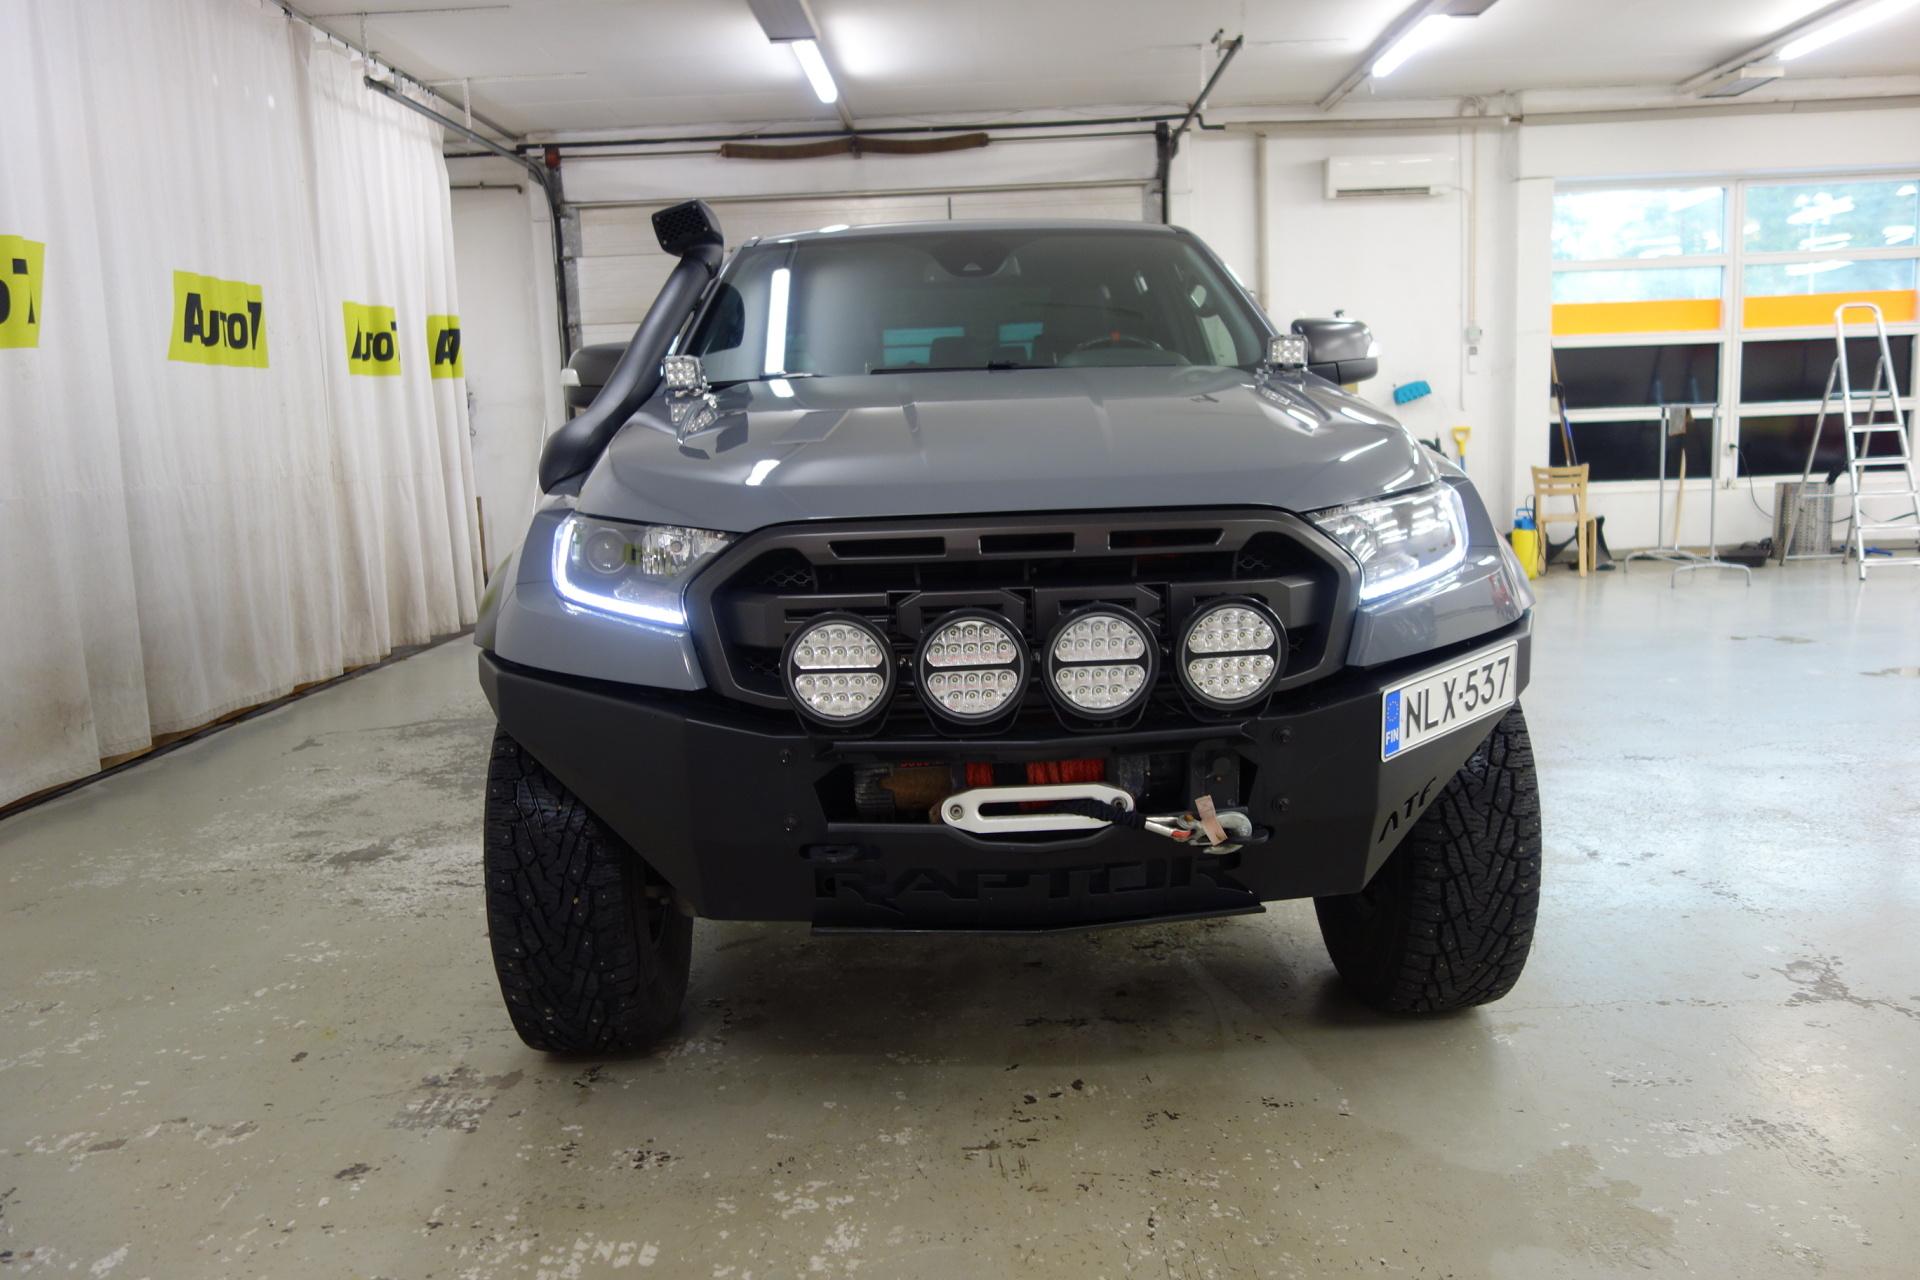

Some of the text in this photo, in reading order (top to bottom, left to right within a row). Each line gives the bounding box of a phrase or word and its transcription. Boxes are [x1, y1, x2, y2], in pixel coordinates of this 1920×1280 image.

[1406, 656, 1510, 739] NLX-537
[1385, 727, 1399, 746] FIN
[814, 853, 1254, 917] RAPTOR
